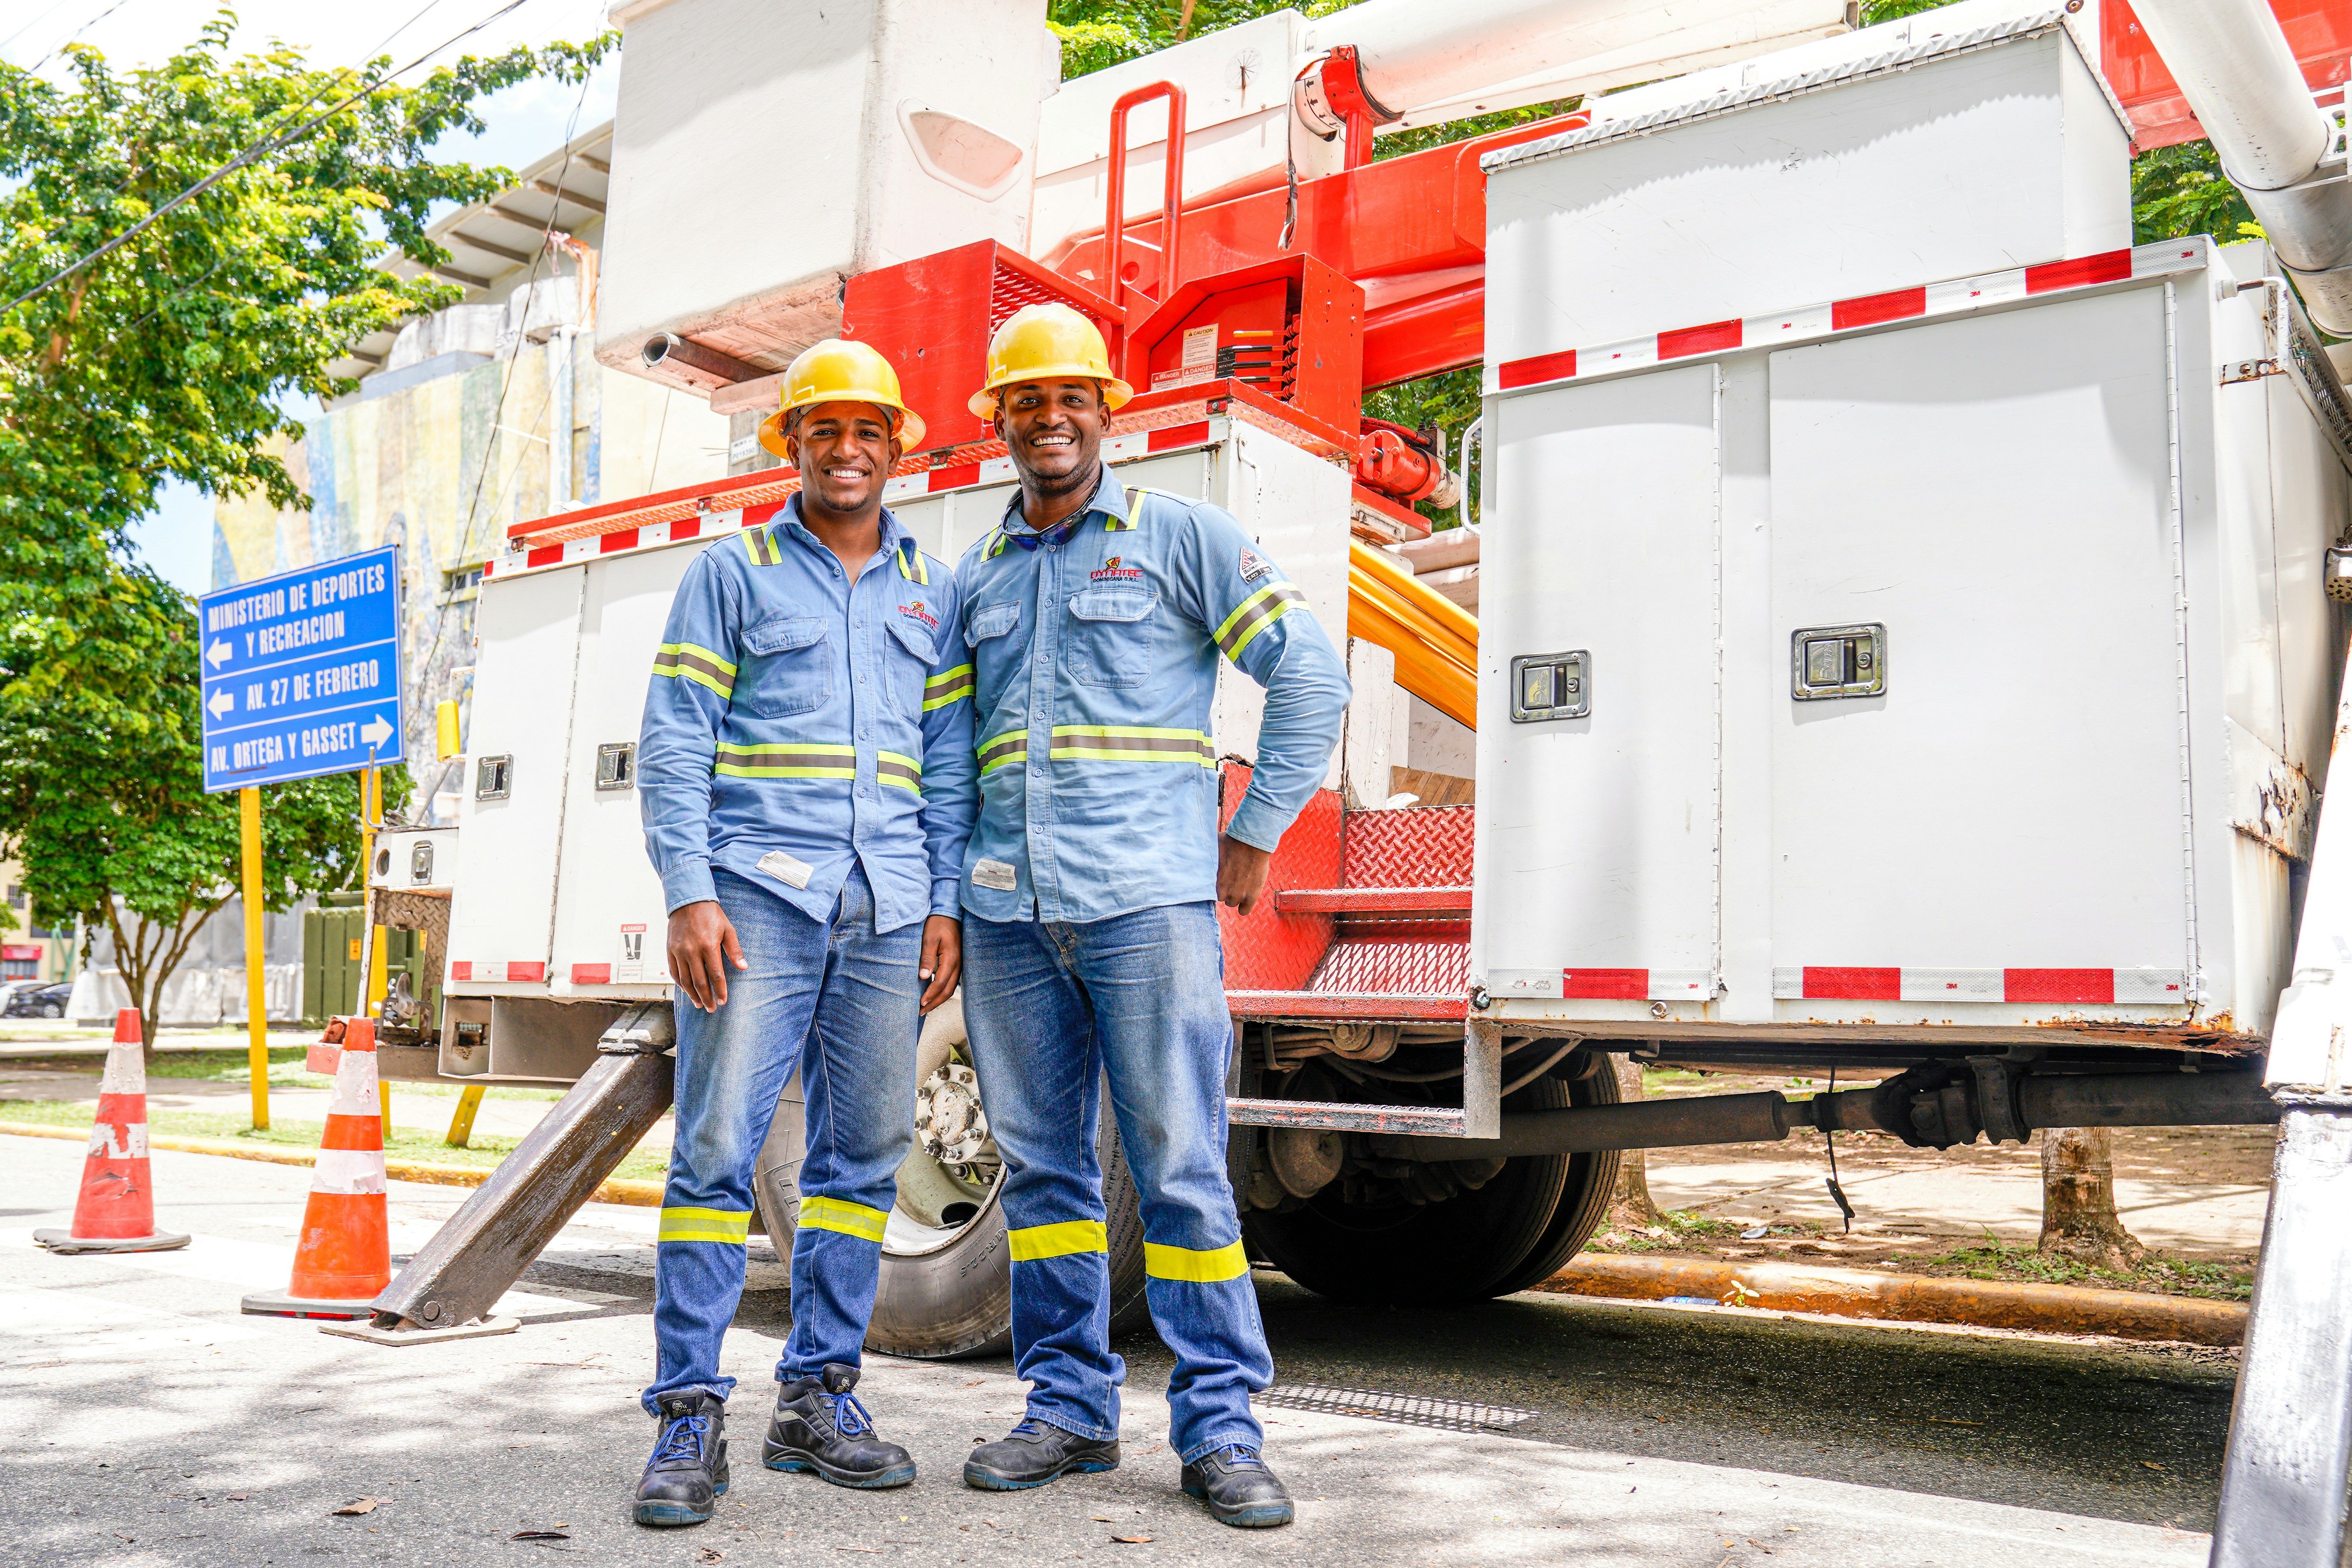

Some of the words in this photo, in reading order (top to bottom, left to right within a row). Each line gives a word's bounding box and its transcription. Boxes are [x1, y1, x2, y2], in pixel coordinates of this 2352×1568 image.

[1160, 372, 1179, 380] DANGER
[1190, 364, 1213, 374] DANGER
[1091, 569, 1144, 579] DYNATEC
[208, 588, 285, 633] MINISTERIO
[289, 583, 307, 612] DE
[311, 563, 385, 607] DEPORTES
[245, 632, 255, 658] Y
[260, 611, 345, 655] RECREACION
[247, 683, 266, 711] AV.
[271, 677, 288, 706] 27
[294, 673, 311, 701] DE
[316, 659, 379, 698] FEBRERO
[211, 746, 230, 773] AV.
[234, 735, 284, 769] ORTEGA
[287, 732, 297, 759] Y
[302, 722, 356, 756] GASSET
